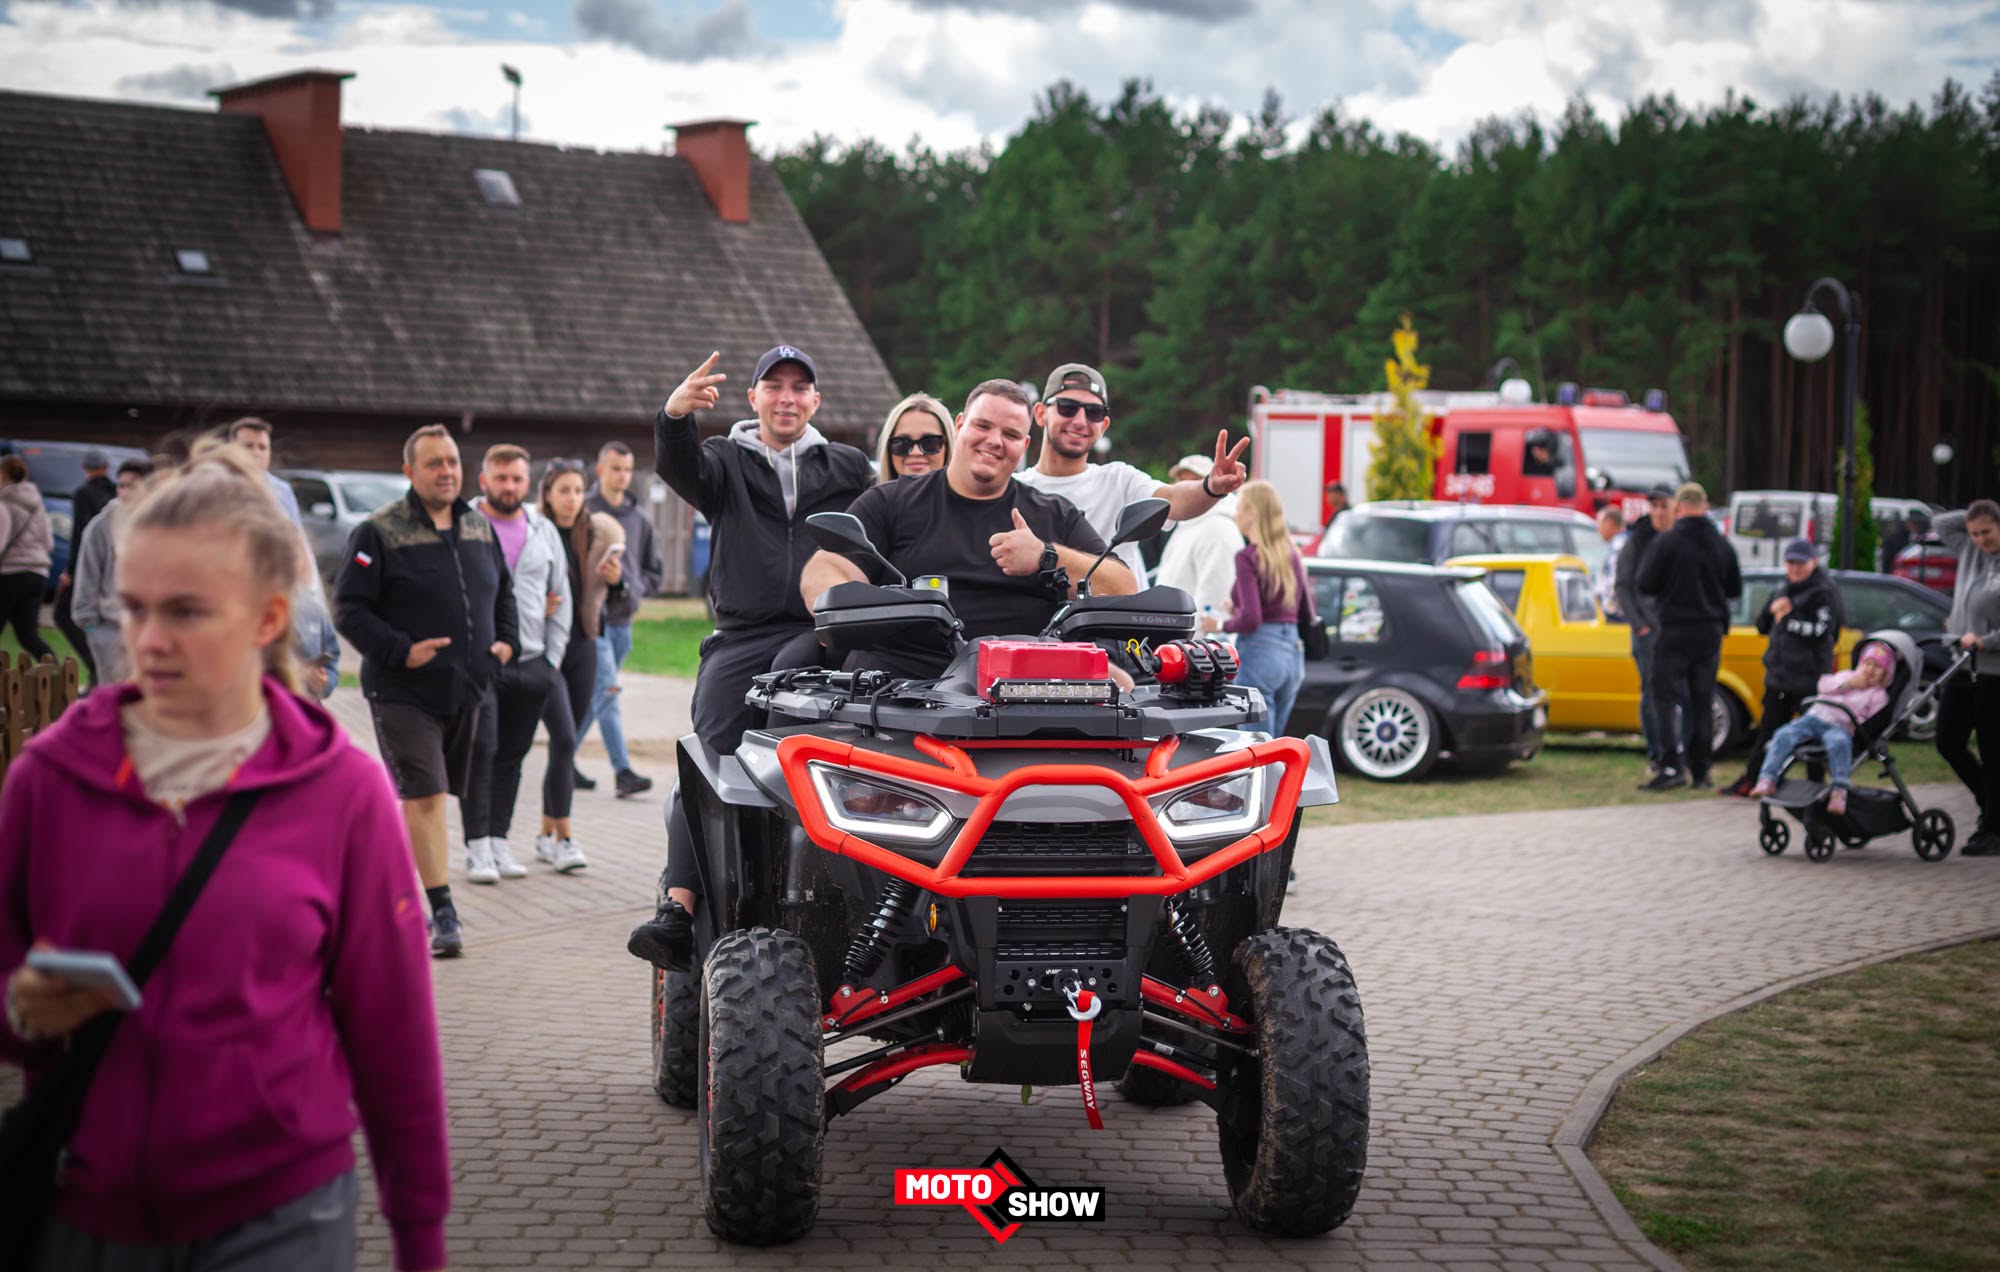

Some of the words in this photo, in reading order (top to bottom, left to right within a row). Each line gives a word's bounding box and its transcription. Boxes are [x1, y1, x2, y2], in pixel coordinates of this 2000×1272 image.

[779, 345, 796, 359] LA
[1130, 615, 1178, 625] SEGWAY
[1080, 1049, 1096, 1110] SEGWAY
